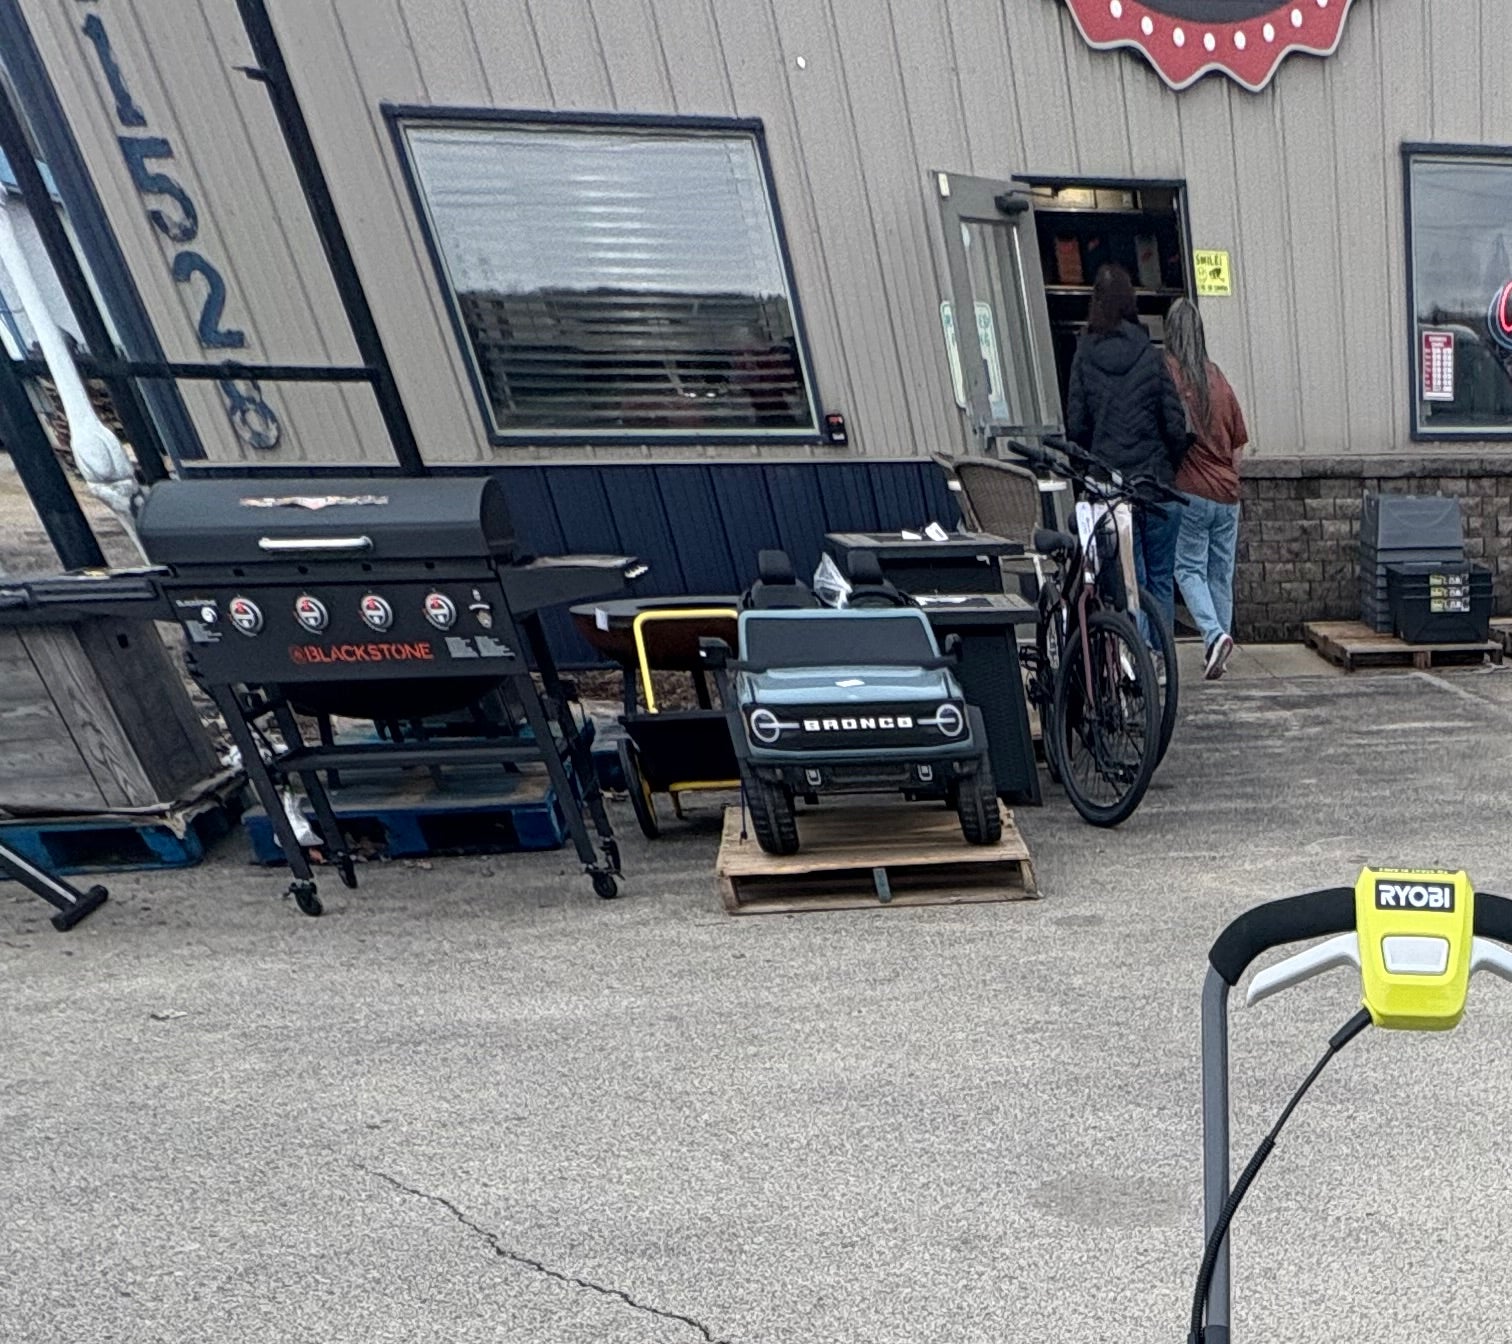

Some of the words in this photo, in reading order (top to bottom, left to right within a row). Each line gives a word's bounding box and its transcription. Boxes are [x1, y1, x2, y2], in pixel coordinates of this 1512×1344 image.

[304, 643, 434, 663] BLACKSTONE
[803, 716, 913, 732] BRONCO
[1379, 884, 1450, 908] RYOBI
